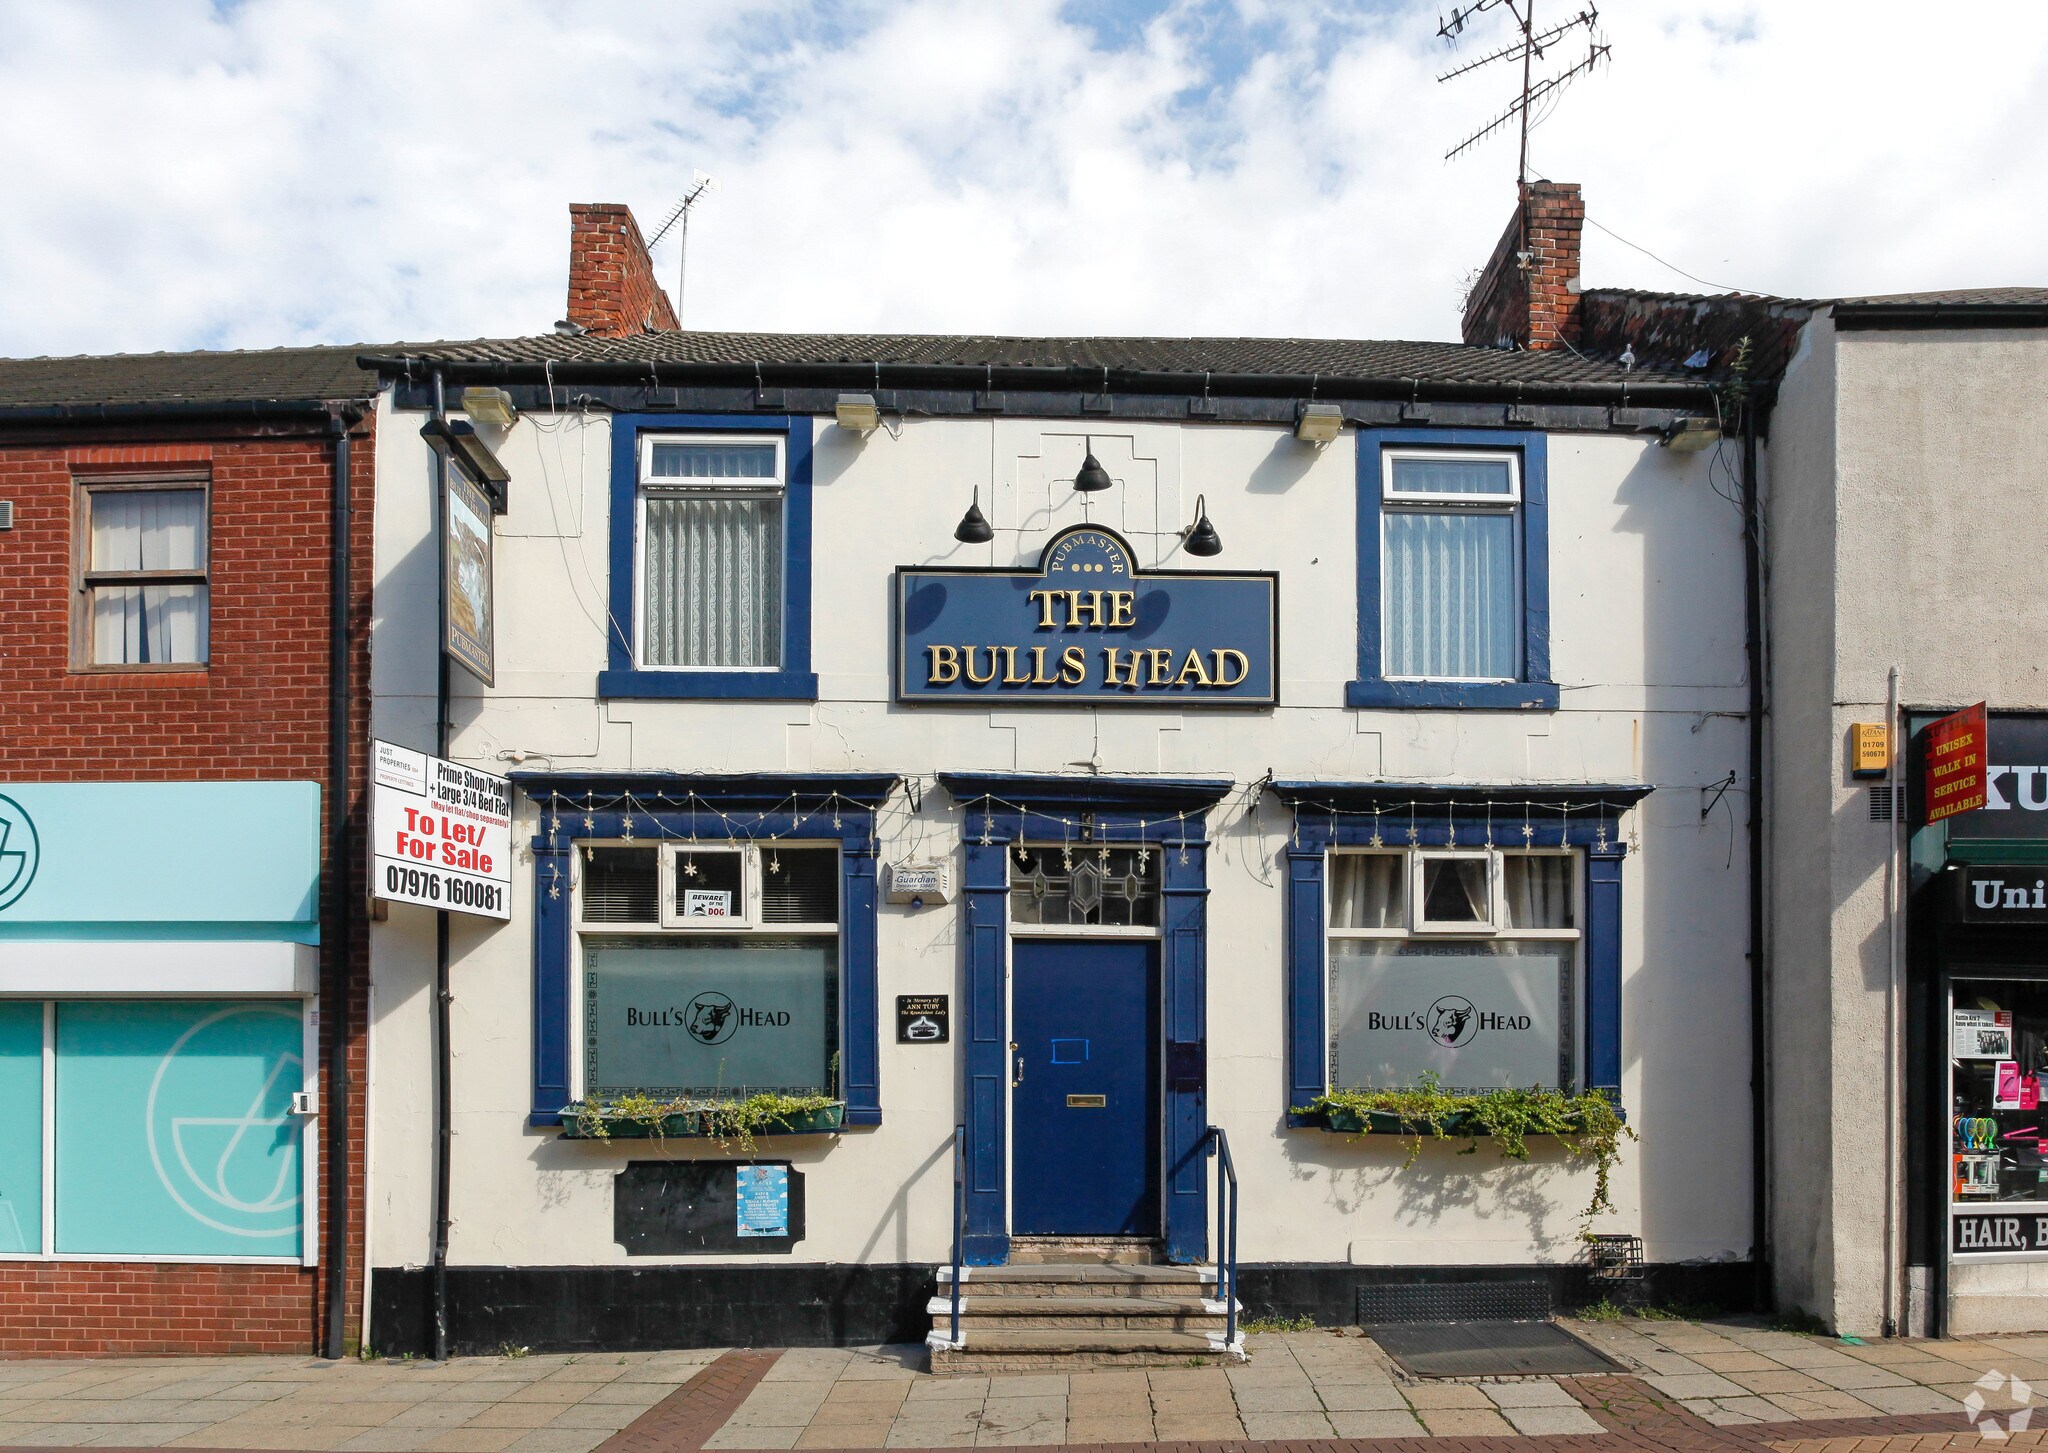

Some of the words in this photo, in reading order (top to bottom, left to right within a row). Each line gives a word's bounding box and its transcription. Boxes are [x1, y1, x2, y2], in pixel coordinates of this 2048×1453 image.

[1051, 535, 1124, 574] PUBMASTER
[1030, 589, 1137, 627] THE
[451, 626, 490, 670] PUBMASTER
[927, 644, 1086, 684] BULLS
[1104, 647, 1250, 688] HEAD
[1861, 729, 1886, 737] KATANA
[1935, 733, 1974, 757] UNISEX
[379, 756, 411, 771] PROPERTIES
[380, 747, 393, 756] JUST
[1862, 750, 1886, 758] 590678
[1933, 759, 1962, 778] WALK
[1964, 753, 1977, 767] IN
[438, 762, 463, 786] Prime
[464, 770, 503, 798] Shop/Pub
[1934, 775, 1976, 798] SERVICE
[430, 783, 436, 793] +
[437, 781, 462, 805] Large
[463, 789, 477, 808] 3/4
[479, 793, 494, 813] Bed
[495, 798, 509, 817] Flat
[1929, 794, 1983, 820] AVAILABLE
[404, 807, 435, 836] To
[441, 816, 487, 847] Let/
[431, 800, 445, 812] (May
[446, 804, 454, 814] let
[455, 806, 480, 821] flat/shop
[480, 814, 509, 829] separately)
[397, 831, 437, 861] For
[442, 842, 493, 874] Sale
[386, 865, 440, 901] 07976
[444, 877, 502, 912] 160081
[896, 875, 936, 884] Guardian
[1971, 879, 2047, 909] Uni
[708, 907, 725, 916] DOG
[627, 1006, 684, 1026] BULL'S
[740, 1007, 791, 1027] HEAD
[1368, 1011, 1425, 1031] BULL'S
[1480, 1011, 1531, 1031] HEAD
[1960, 1217, 2027, 1251] HAIR,
